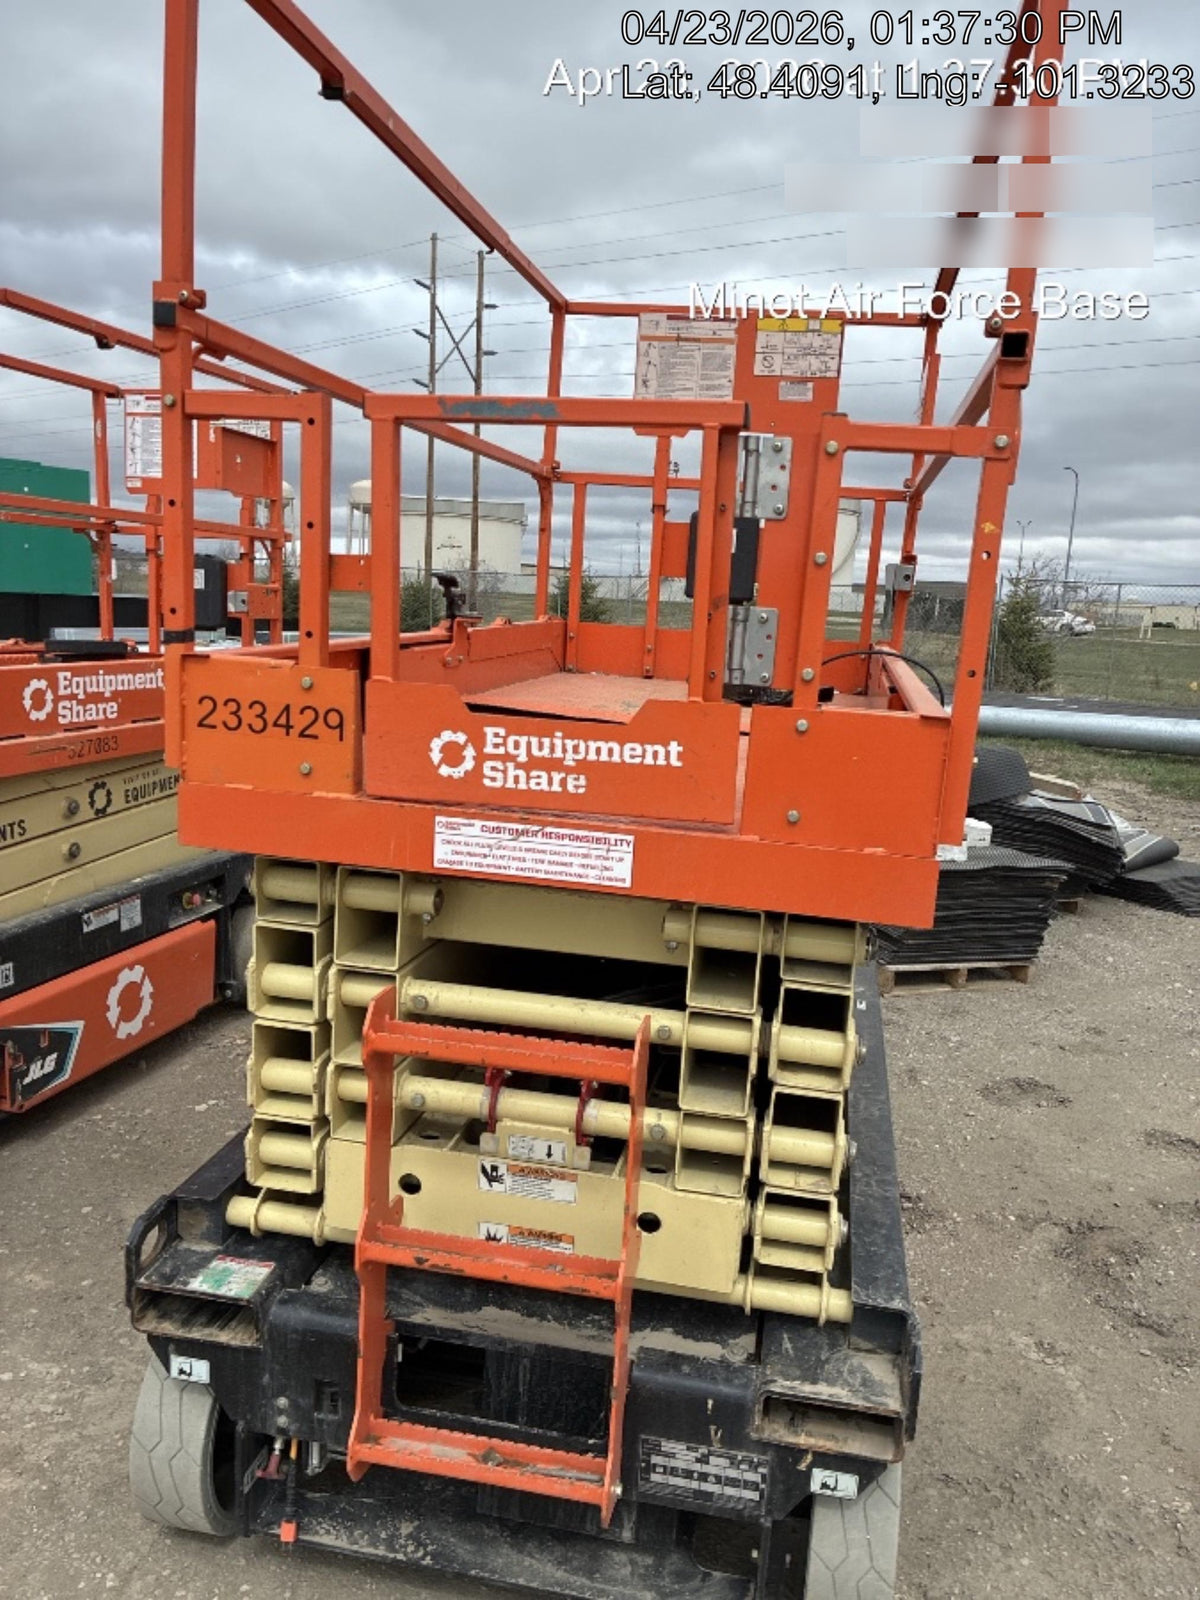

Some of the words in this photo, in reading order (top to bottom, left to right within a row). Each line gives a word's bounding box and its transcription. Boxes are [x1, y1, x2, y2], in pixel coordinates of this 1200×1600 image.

[57, 668, 164, 698] Equipment
[57, 698, 119, 725] Share
[197, 695, 344, 742] 233429
[483, 726, 683, 768] Equipment
[482, 759, 588, 794] Share
[480, 823, 539, 839] CUSTOMER
[541, 830, 632, 848] RESPONSIBILITY
